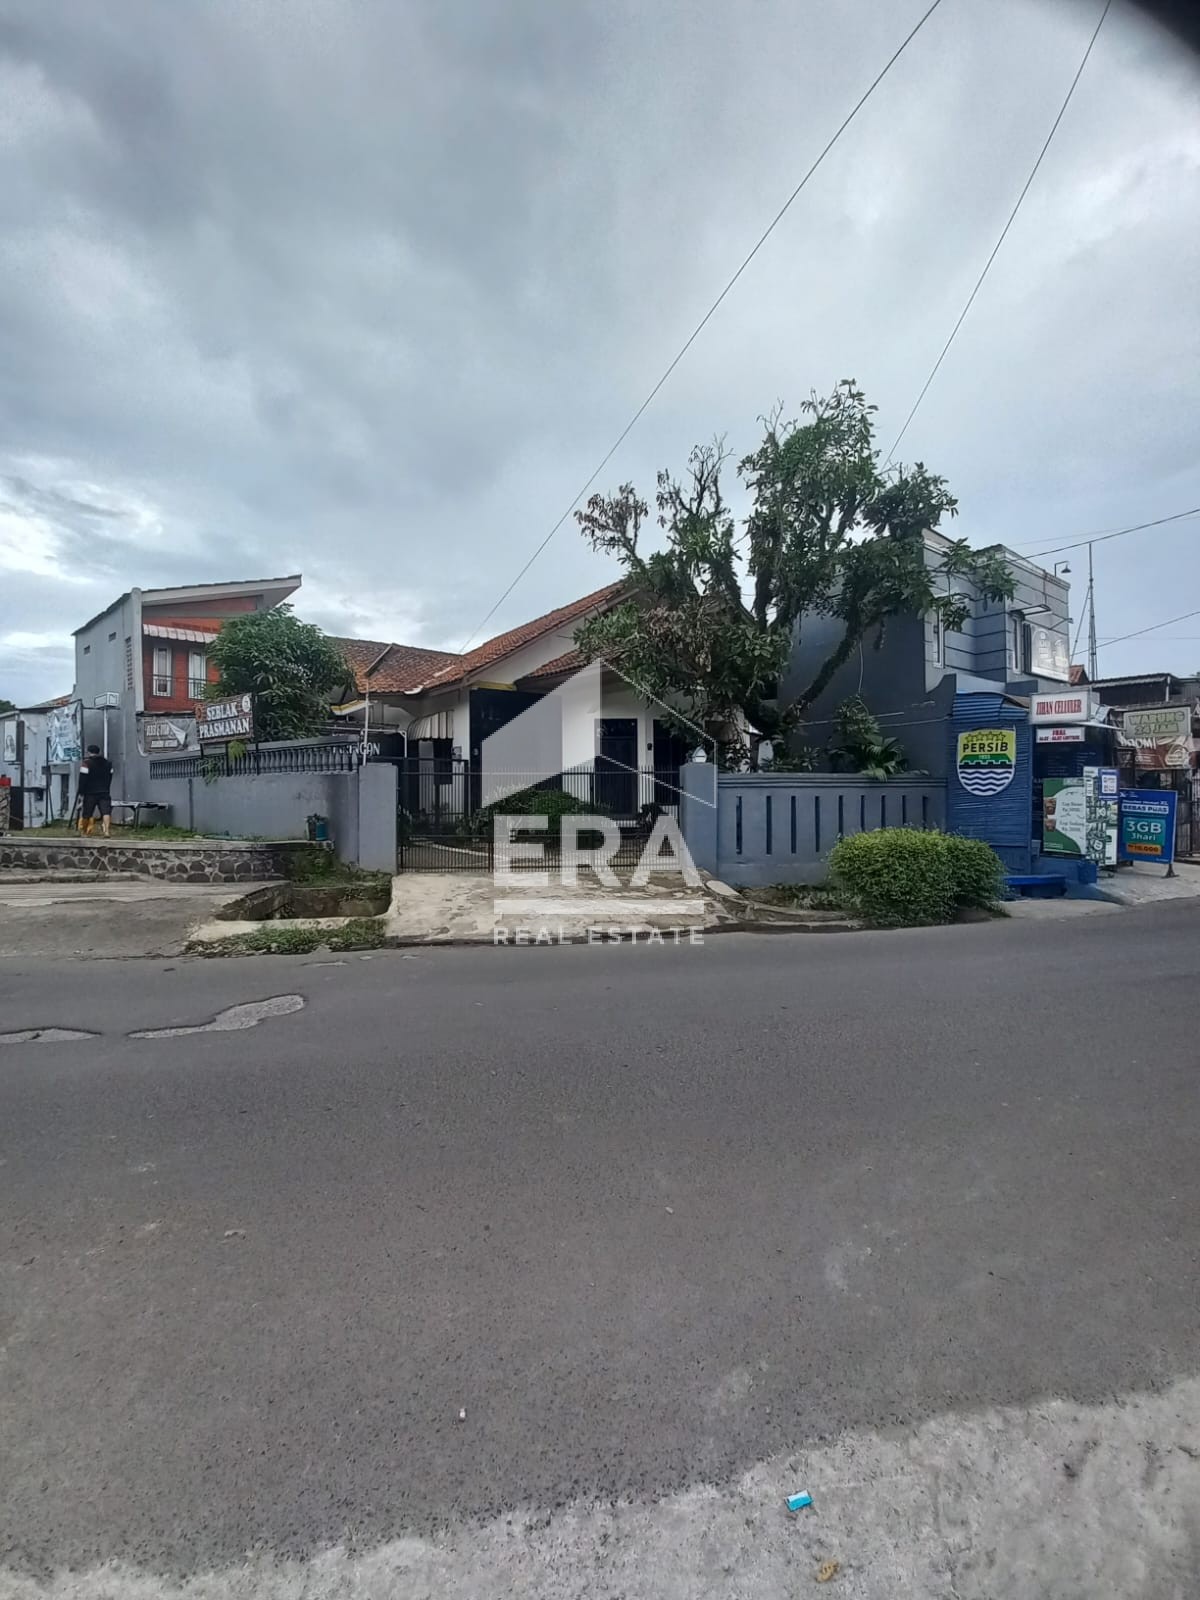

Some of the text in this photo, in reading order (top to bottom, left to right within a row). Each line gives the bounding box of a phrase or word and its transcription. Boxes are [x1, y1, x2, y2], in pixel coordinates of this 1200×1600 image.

[207, 702, 238, 720] SEBLAK
[199, 718, 250, 738] PRASMANAN
[963, 742, 1008, 753] PERSIB
[1126, 820, 1162, 834] 3GB
[1131, 832, 1156, 841] 3hari
